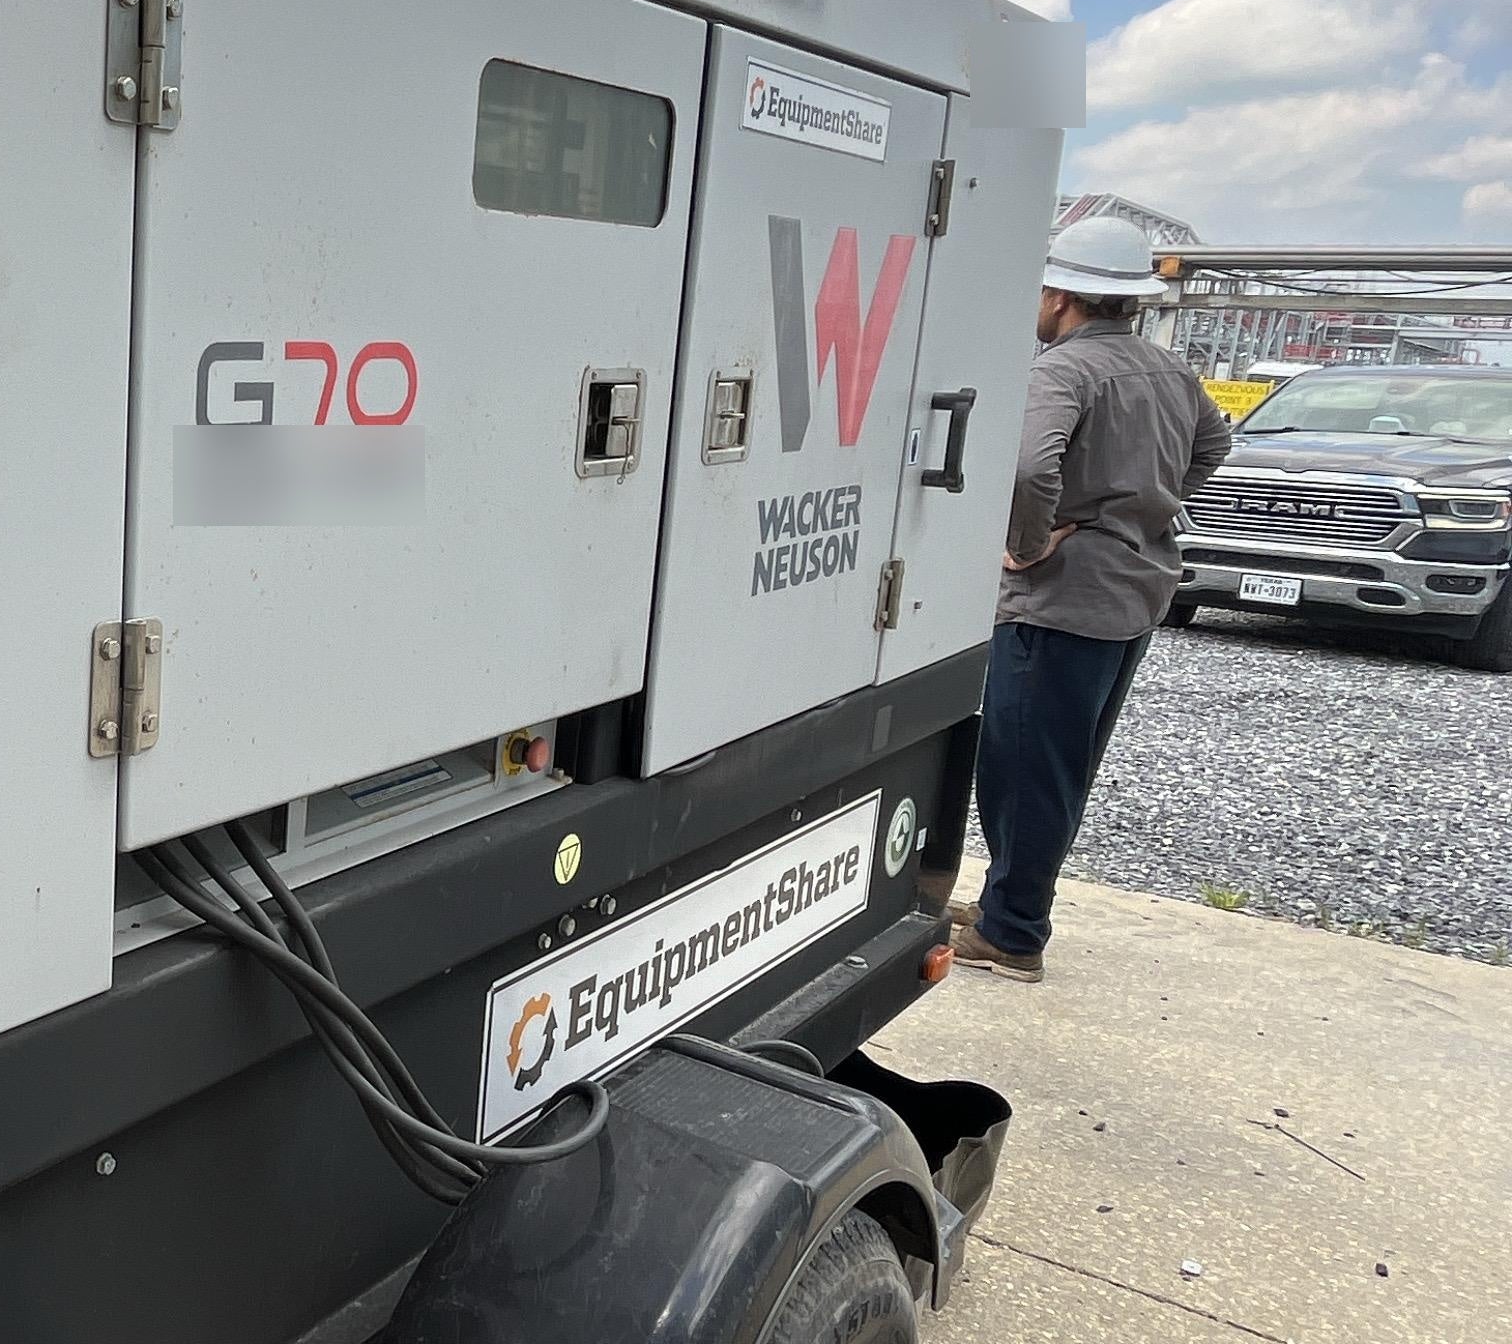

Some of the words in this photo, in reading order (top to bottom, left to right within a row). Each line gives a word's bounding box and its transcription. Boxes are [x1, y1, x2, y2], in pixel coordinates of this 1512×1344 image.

[767, 86, 884, 146] EquipmentShare
[196, 341, 418, 426] G70
[757, 484, 862, 545] WACKER
[1240, 498, 1332, 517] RAM
[751, 530, 860, 597] NEUSON
[564, 844, 860, 1051] EquipmentShare
